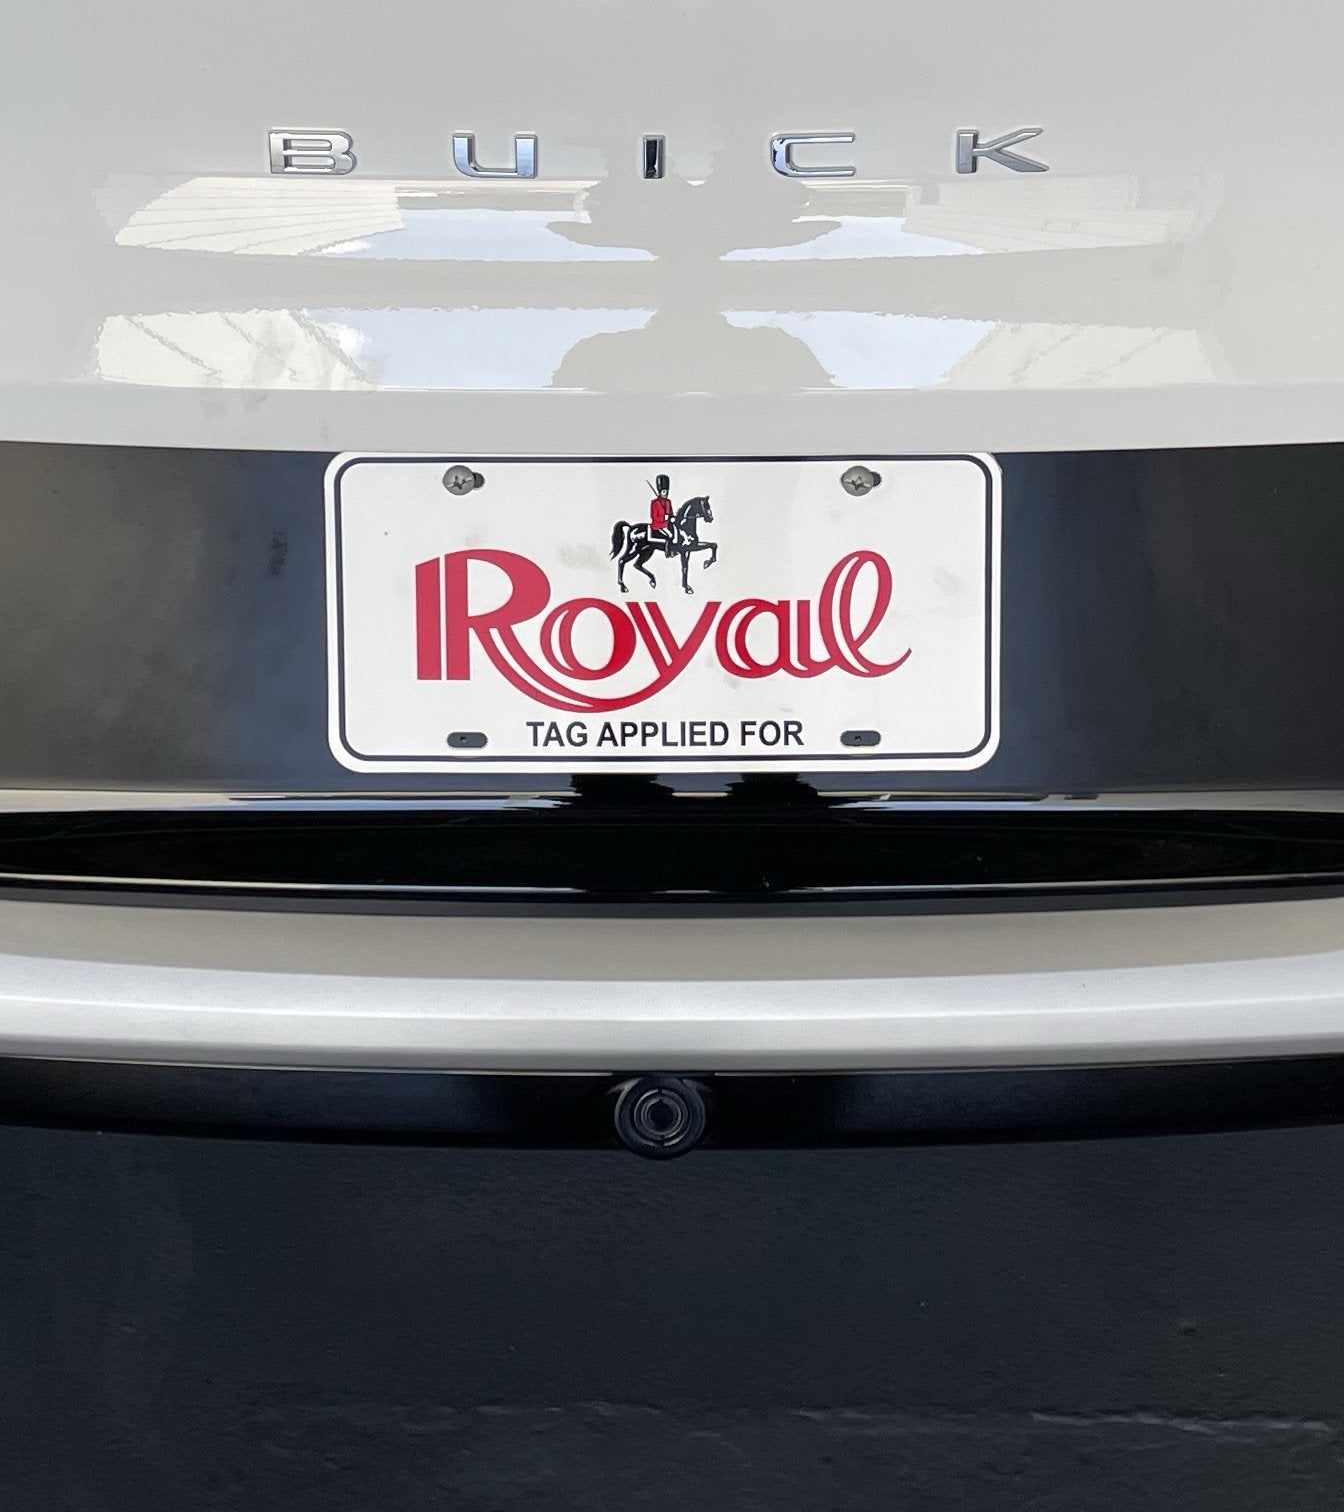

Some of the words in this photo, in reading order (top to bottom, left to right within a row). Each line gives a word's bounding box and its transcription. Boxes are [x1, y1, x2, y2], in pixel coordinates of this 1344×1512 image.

[267, 127, 1050, 179] BUICK
[415, 548, 912, 713] Royal
[526, 720, 587, 748] TAG
[597, 720, 730, 747] APPLIED
[740, 720, 804, 746] FOR
